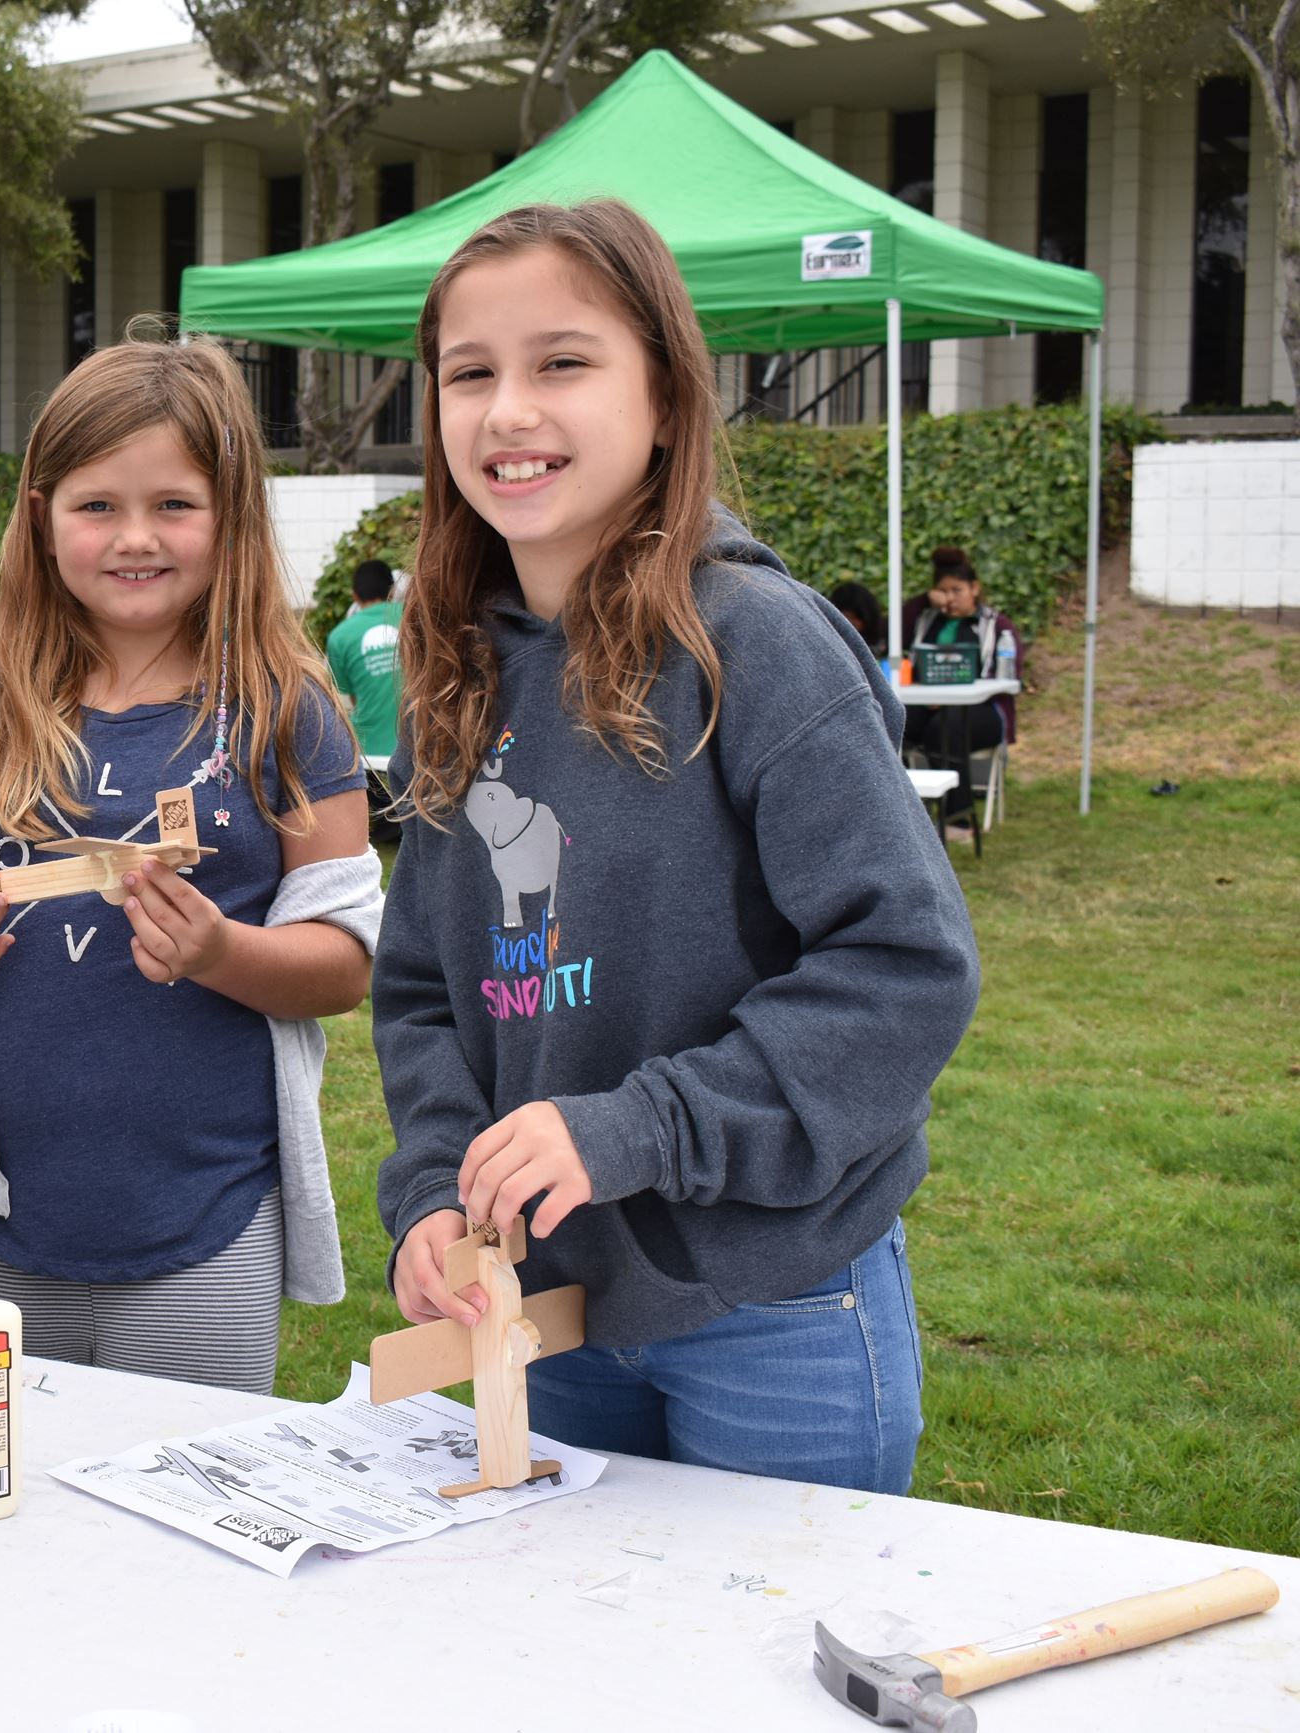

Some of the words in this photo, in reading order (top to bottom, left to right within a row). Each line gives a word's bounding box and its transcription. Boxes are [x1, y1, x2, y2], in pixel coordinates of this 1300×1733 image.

[97, 762, 123, 796] L
[163, 800, 188, 830] HOME
[64, 924, 98, 963] V
[228, 1516, 264, 1532] KIDS
